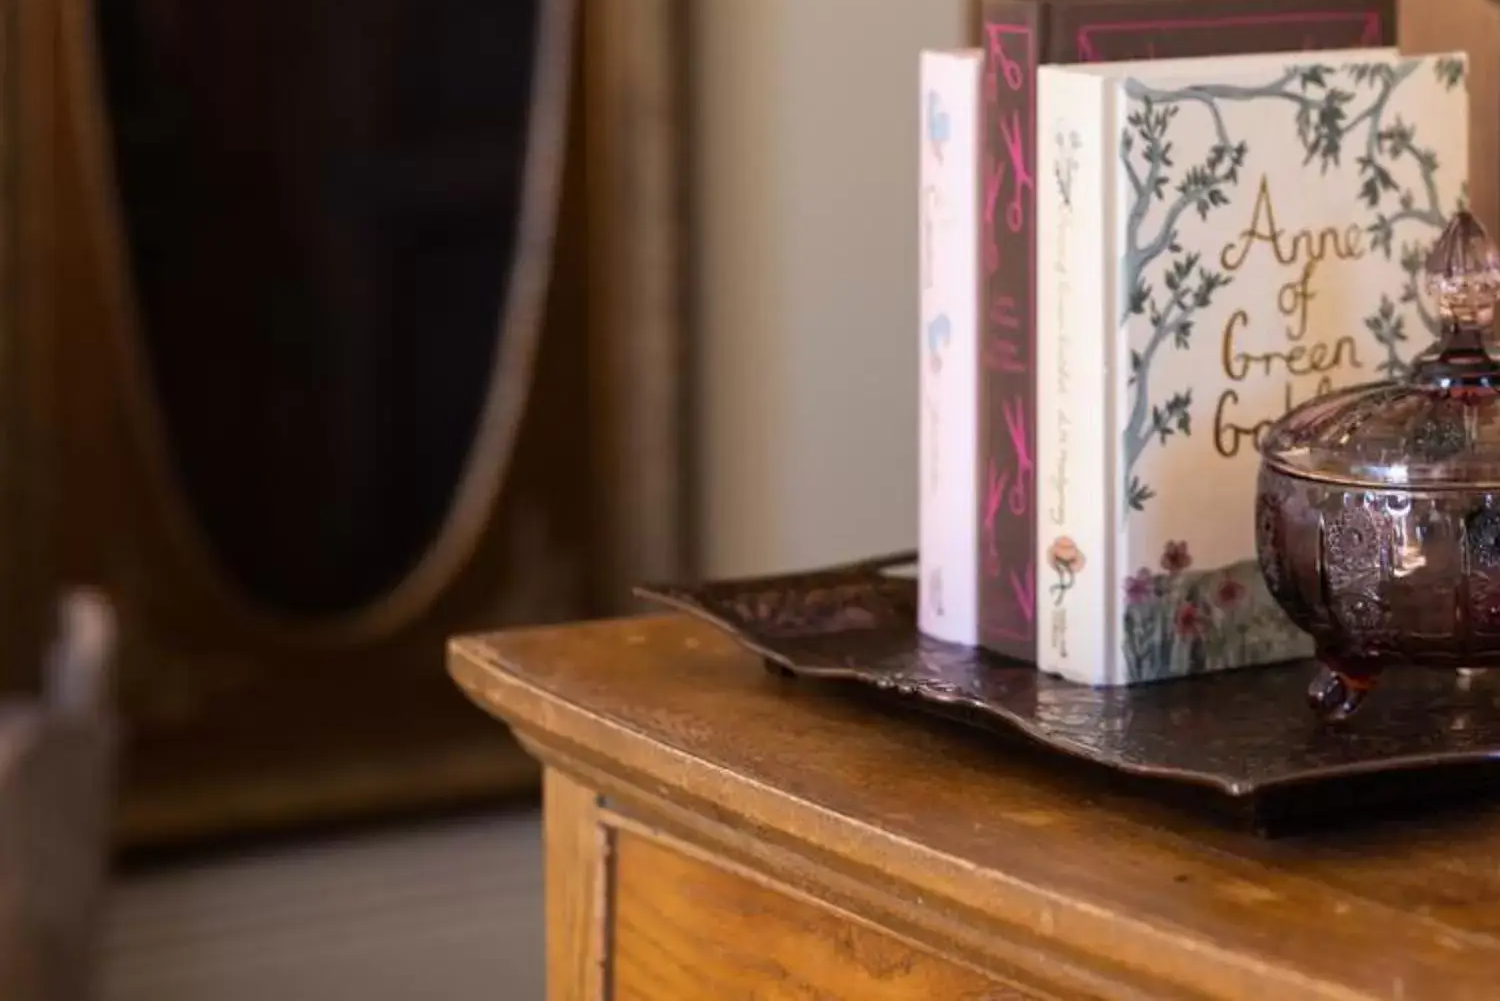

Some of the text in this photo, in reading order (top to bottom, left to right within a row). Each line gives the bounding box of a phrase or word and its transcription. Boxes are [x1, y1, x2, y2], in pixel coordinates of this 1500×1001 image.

[1220, 174, 1365, 270] Anne
[1277, 257, 1317, 340] of
[1222, 310, 1363, 381] Green
